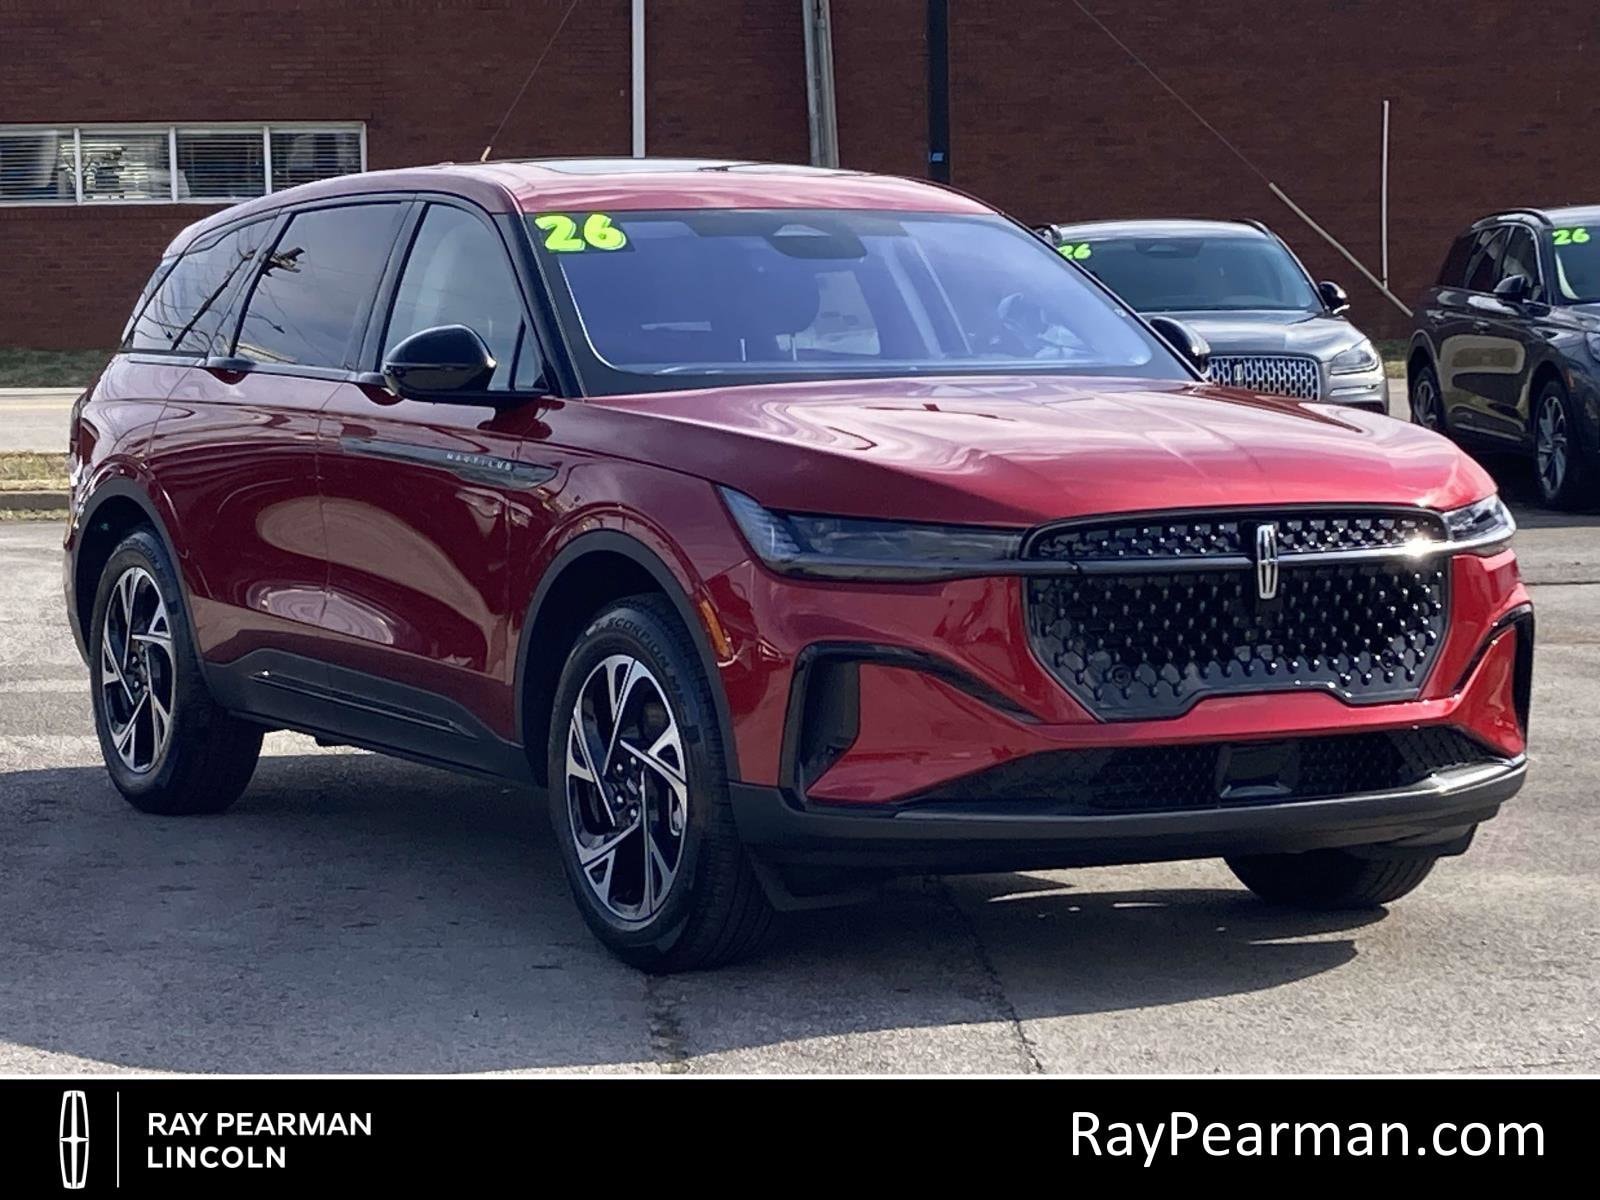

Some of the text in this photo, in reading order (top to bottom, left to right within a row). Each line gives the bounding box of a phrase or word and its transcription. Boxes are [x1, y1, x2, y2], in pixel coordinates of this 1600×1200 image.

[534, 213, 627, 252] 26
[1551, 228, 1590, 246] 26
[1057, 243, 1092, 260] 26
